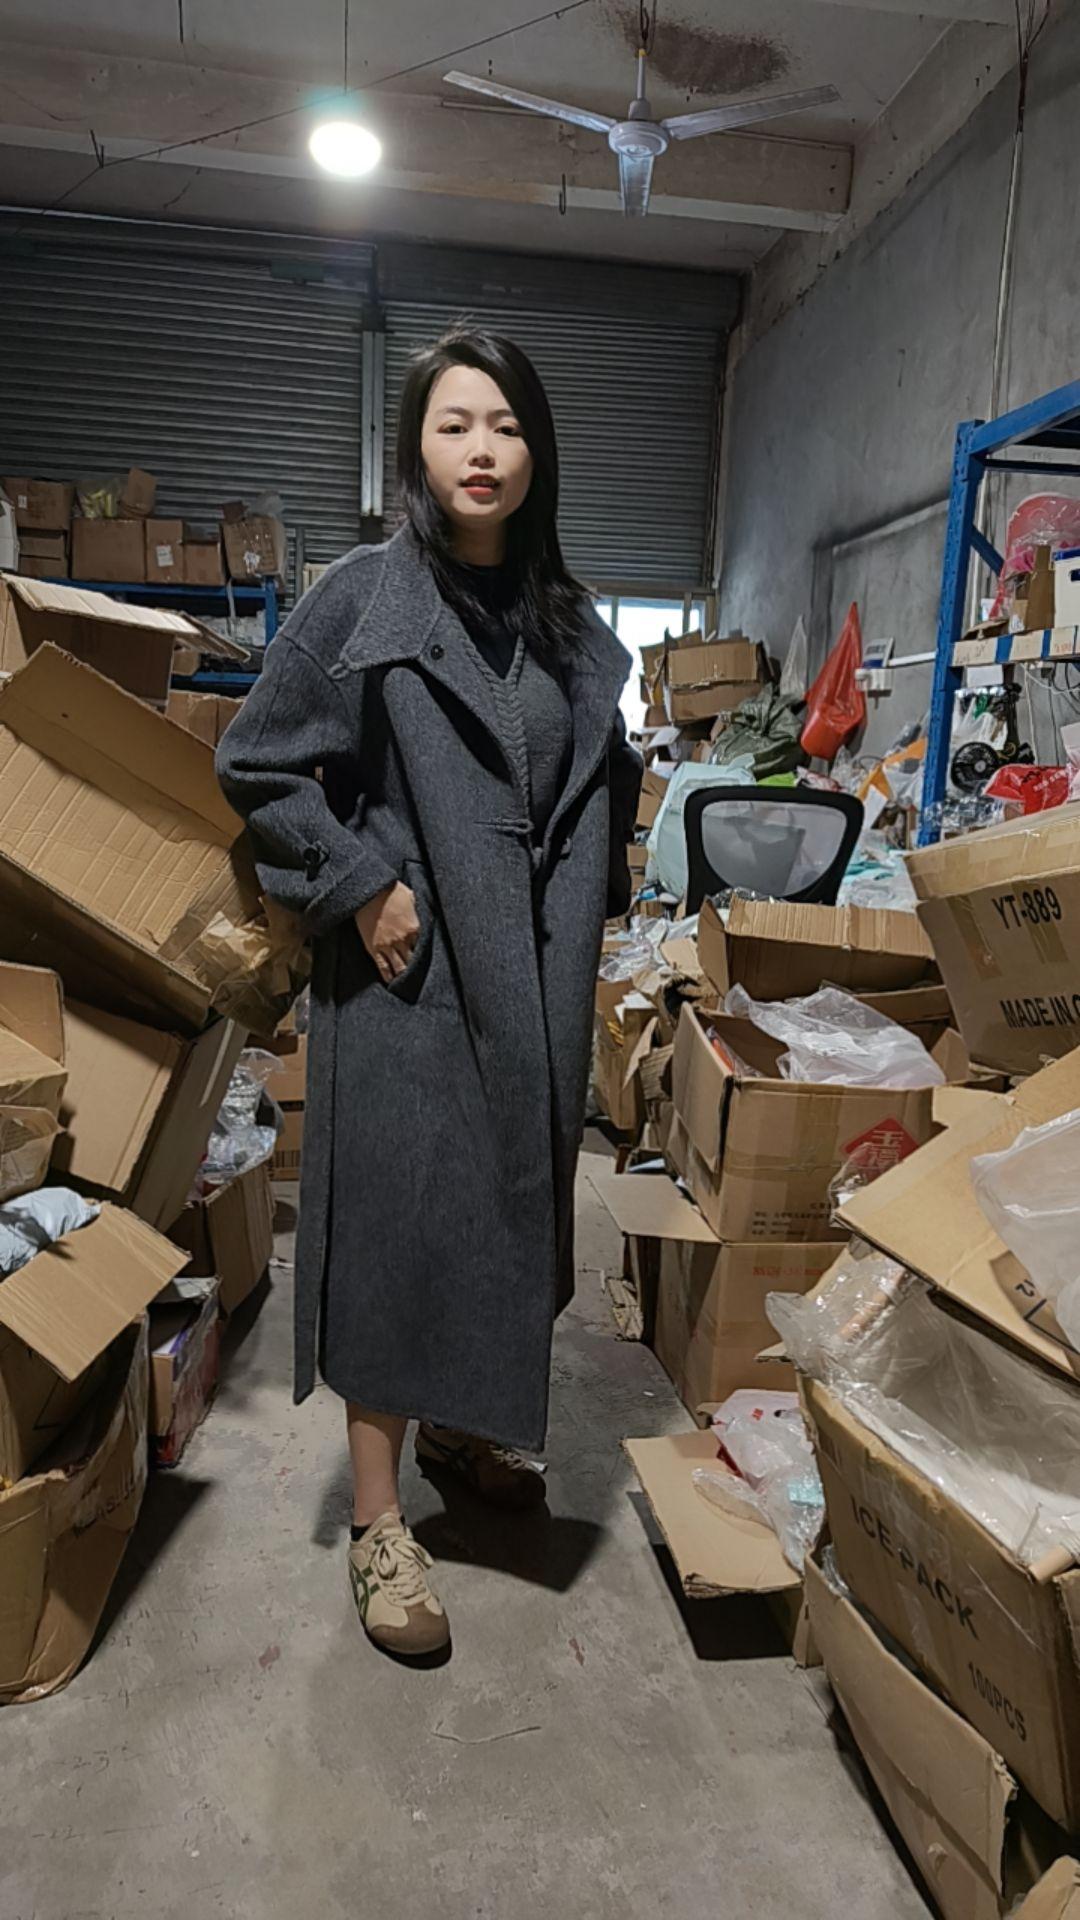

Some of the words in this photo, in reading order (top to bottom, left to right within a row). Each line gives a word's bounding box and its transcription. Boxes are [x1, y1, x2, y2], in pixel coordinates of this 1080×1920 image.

[992, 886, 1062, 930] YT-889
[1000, 997, 1055, 1028] MADE
[1048, 995, 1076, 1025] IN
[850, 1495, 894, 1558] ICE
[899, 1545, 980, 1641] PACK
[968, 1661, 1027, 1742] 100PCS
